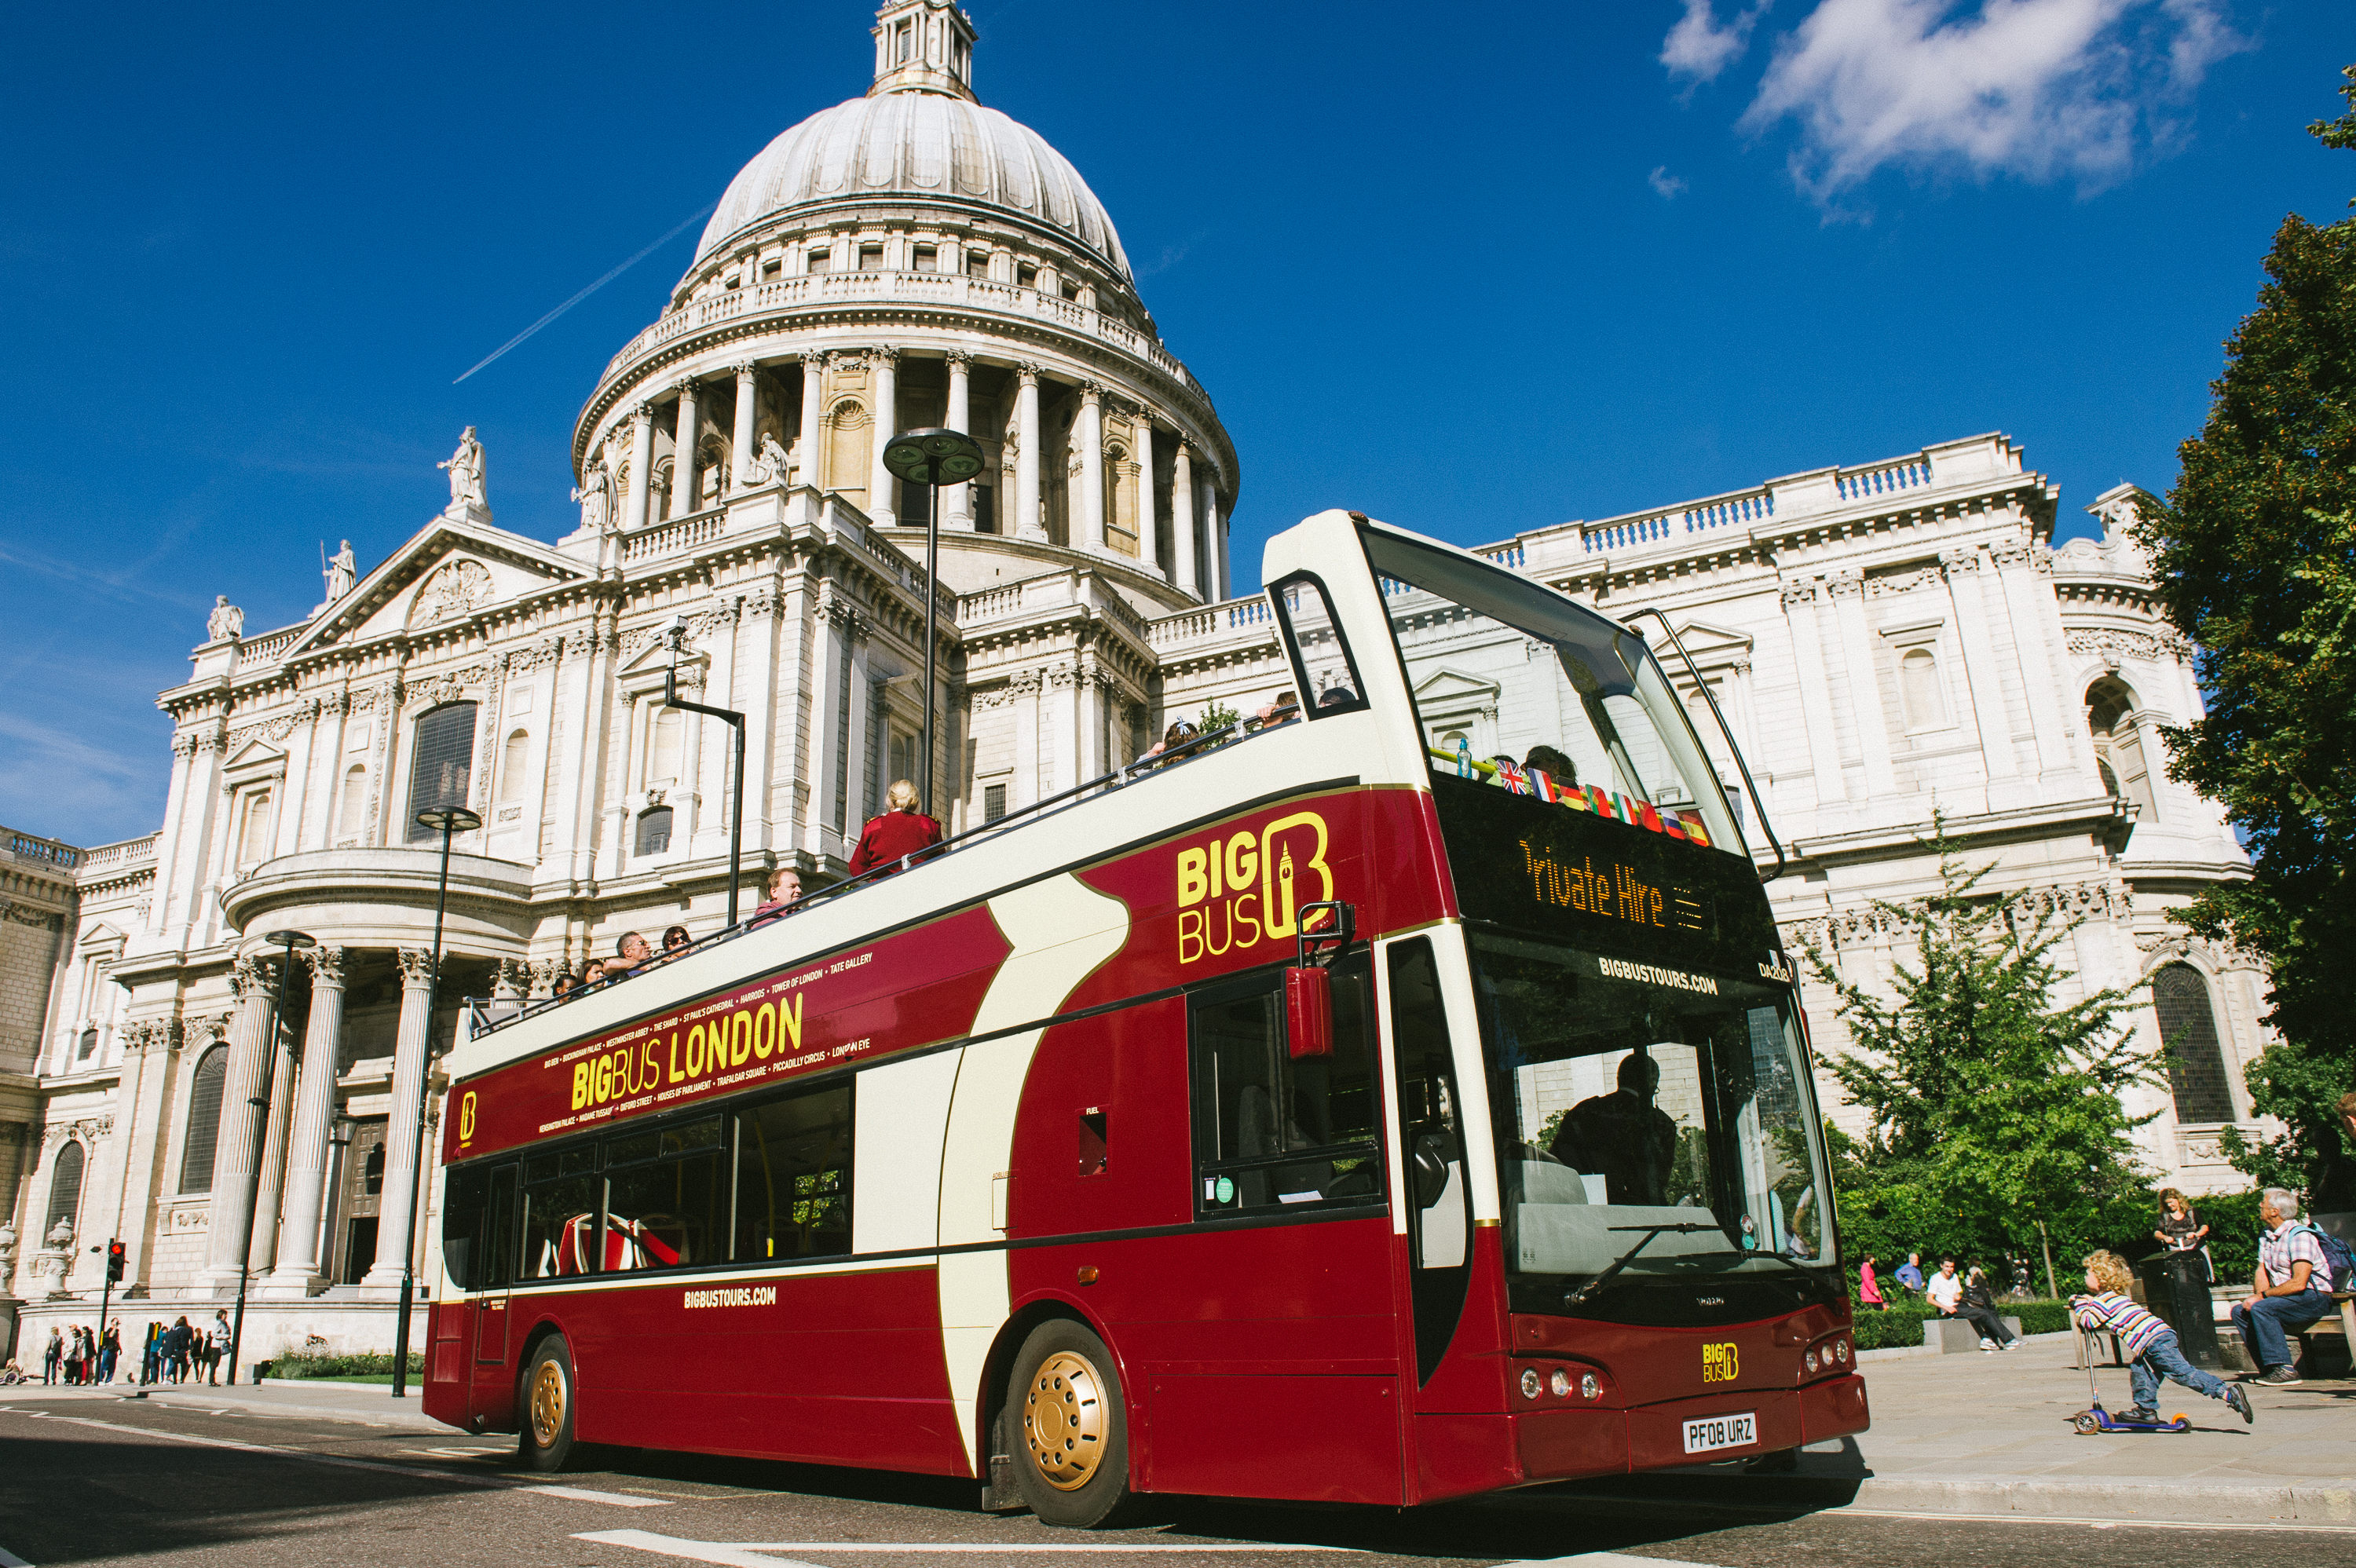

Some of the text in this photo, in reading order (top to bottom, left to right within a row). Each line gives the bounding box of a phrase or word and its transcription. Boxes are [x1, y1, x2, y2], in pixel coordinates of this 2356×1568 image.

[1178, 831, 1257, 908] BIG
[1179, 894, 1260, 963] BUS
[1598, 957, 1718, 996] BIGBUSTOURS.COM
[1758, 962, 1791, 982] DA208
[551, 1057, 559, 1066] BEN
[562, 1047, 587, 1062] BUCKINGHAM
[587, 1042, 602, 1054] PALACE
[605, 1031, 635, 1048] WESTMINSTER
[635, 1026, 649, 1039] ABBEY
[653, 1022, 663, 1033] THE
[662, 1017, 679, 1029] SHARD
[683, 1013, 690, 1022] ST
[690, 1007, 706, 1021] PAUL'S
[706, 999, 734, 1015] CATHEDRAL
[740, 989, 765, 1004] HARRODS
[771, 979, 790, 994] TOWER
[791, 977, 799, 987] OF
[799, 968, 823, 985] LONDON
[830, 961, 845, 974] TATE
[845, 952, 873, 970] GALLERY
[669, 992, 803, 1083] LONDON
[539, 1120, 562, 1133] KENSINGTON
[561, 1116, 576, 1128] PALACE
[579, 1110, 595, 1123] MADAME
[620, 1099, 636, 1112] OXFORD
[636, 1095, 653, 1108] STREET
[657, 1089, 675, 1102] HOUSES
[675, 1087, 682, 1097] OF
[682, 1080, 712, 1095] PARLIAMENT
[717, 1071, 745, 1087] TRAFALGAR
[745, 1065, 767, 1080] SQUARE
[773, 1056, 804, 1073] PICCADILLY
[803, 1051, 825, 1065] CIRCUS
[832, 1041, 858, 1057] LONDN
[858, 1037, 870, 1051] EYE
[1086, 1106, 1099, 1115] FUEL
[684, 1286, 776, 1309] BIGBUSTOURS.COM
[1703, 1343, 1723, 1364] BIG
[1703, 1364, 1724, 1383] BUS
[1689, 1418, 1753, 1449] PF08 URZ
